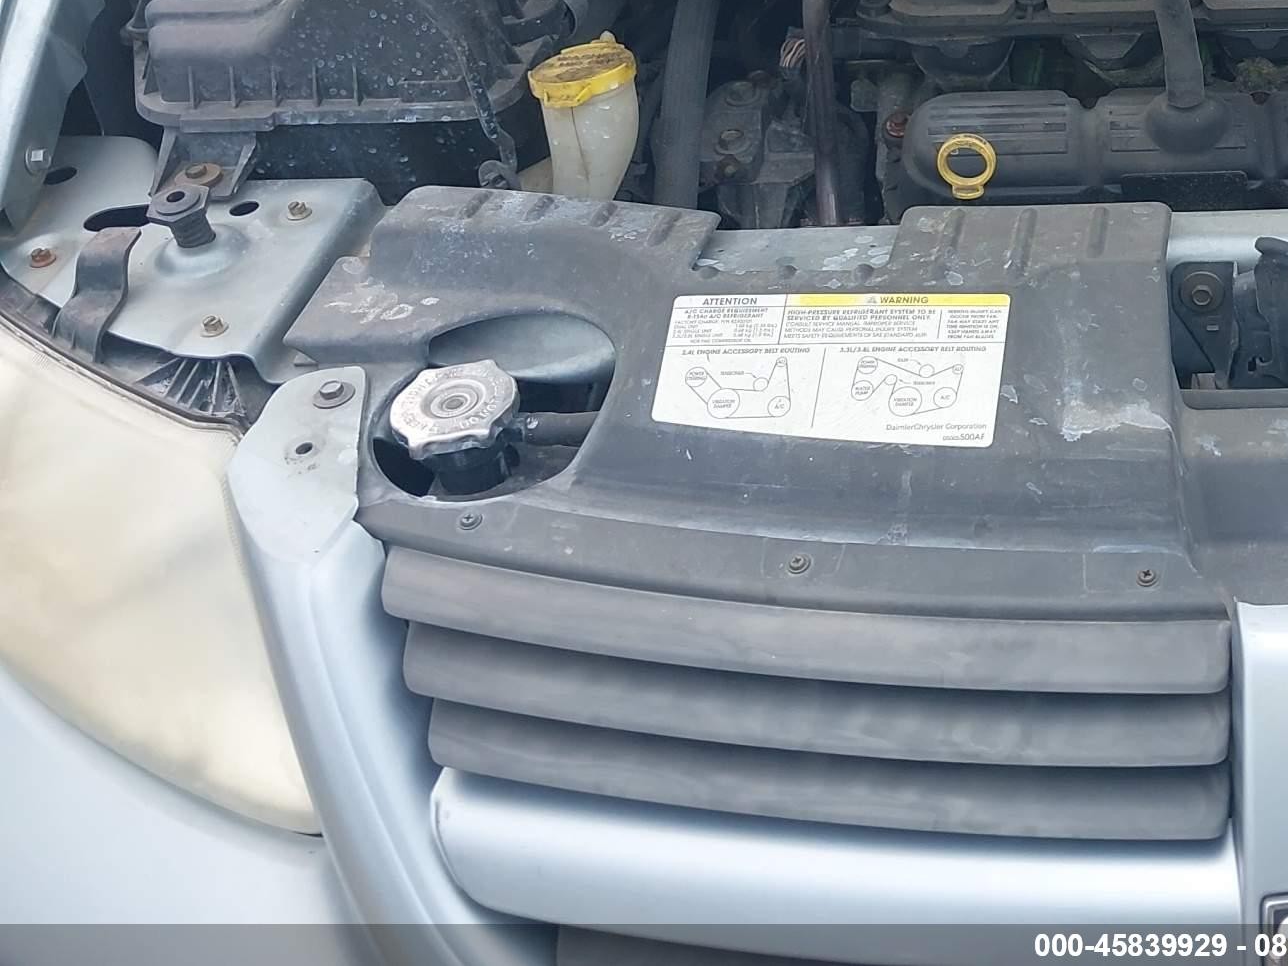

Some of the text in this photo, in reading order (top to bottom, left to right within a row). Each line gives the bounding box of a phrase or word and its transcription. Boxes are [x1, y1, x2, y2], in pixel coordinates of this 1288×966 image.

[702, 297, 758, 306] ATTENTION
[880, 296, 929, 304] WARNING
[886, 423, 987, 432] DaimlerChrysler Corporation
